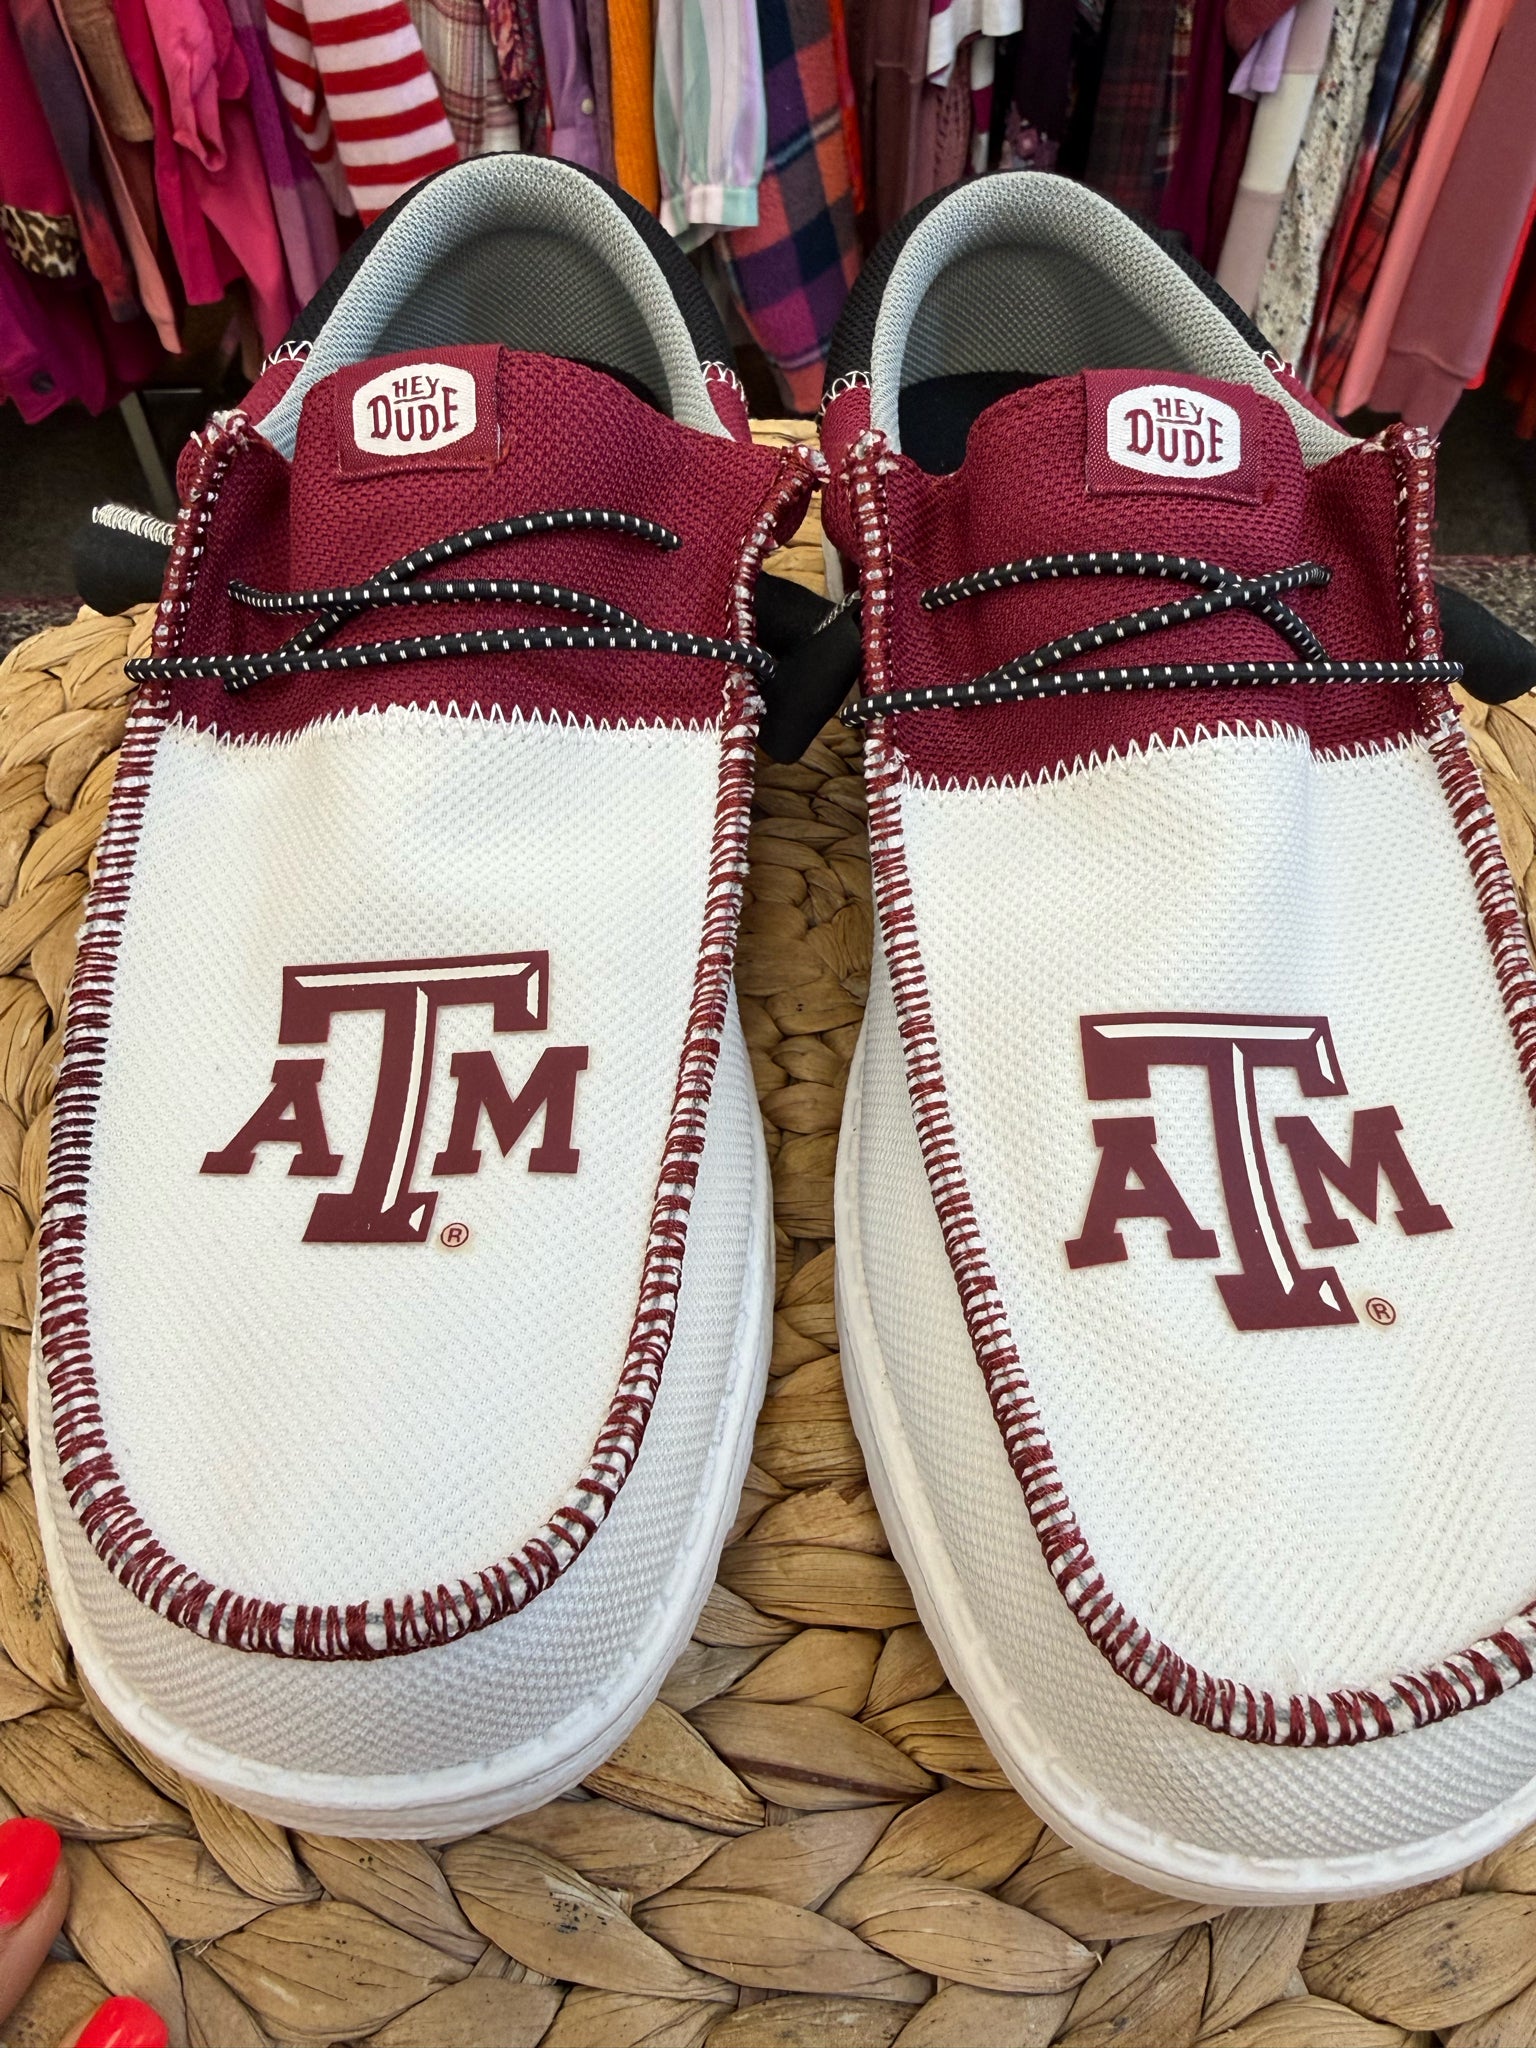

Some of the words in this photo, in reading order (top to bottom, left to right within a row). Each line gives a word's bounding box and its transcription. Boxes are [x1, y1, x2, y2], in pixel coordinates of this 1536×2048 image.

[392, 375, 440, 401] HEY
[366, 386, 459, 441] DUDE
[1153, 397, 1204, 425] HEY
[1124, 408, 1223, 467] DUDE
